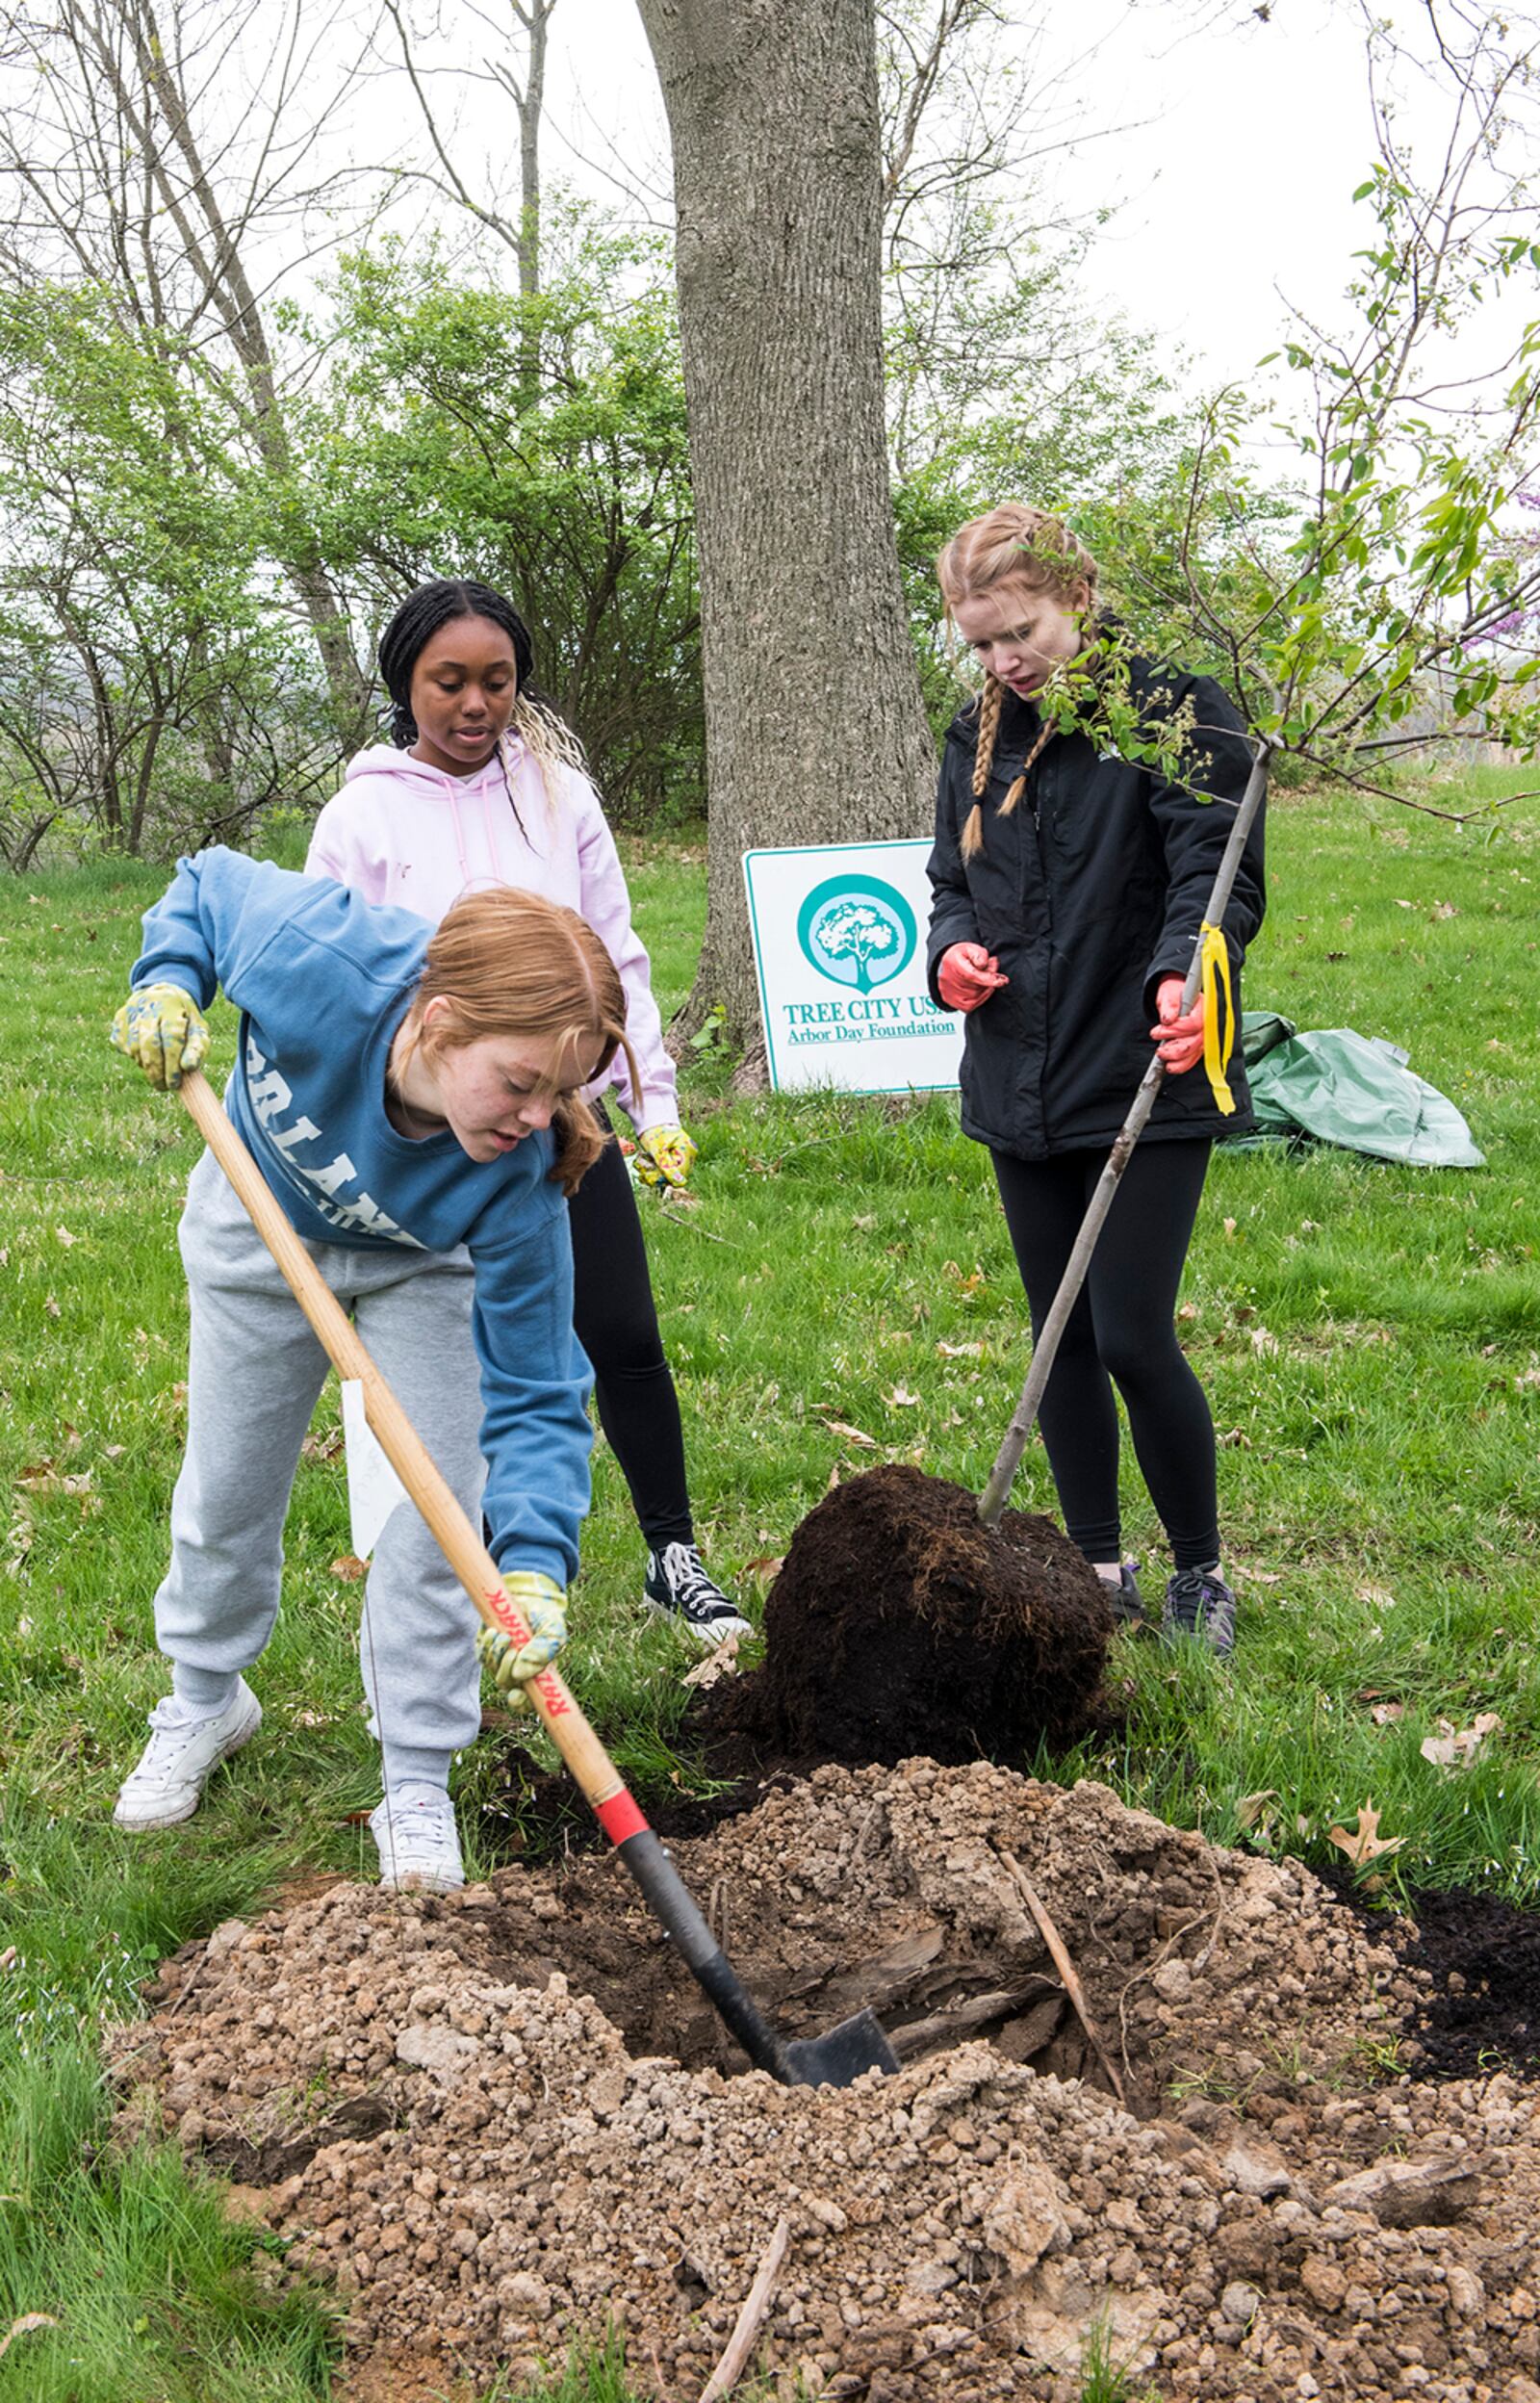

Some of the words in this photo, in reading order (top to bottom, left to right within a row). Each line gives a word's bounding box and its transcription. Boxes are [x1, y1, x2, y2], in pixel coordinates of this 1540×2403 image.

[783, 1002, 845, 1024] TREE
[848, 997, 901, 1021] CITY
[908, 995, 948, 1017] US
[788, 1028, 832, 1044] Arbor
[835, 1025, 864, 1044] Day
[869, 1020, 955, 1037] Foundation
[485, 1589, 571, 1718] RAZBACK
